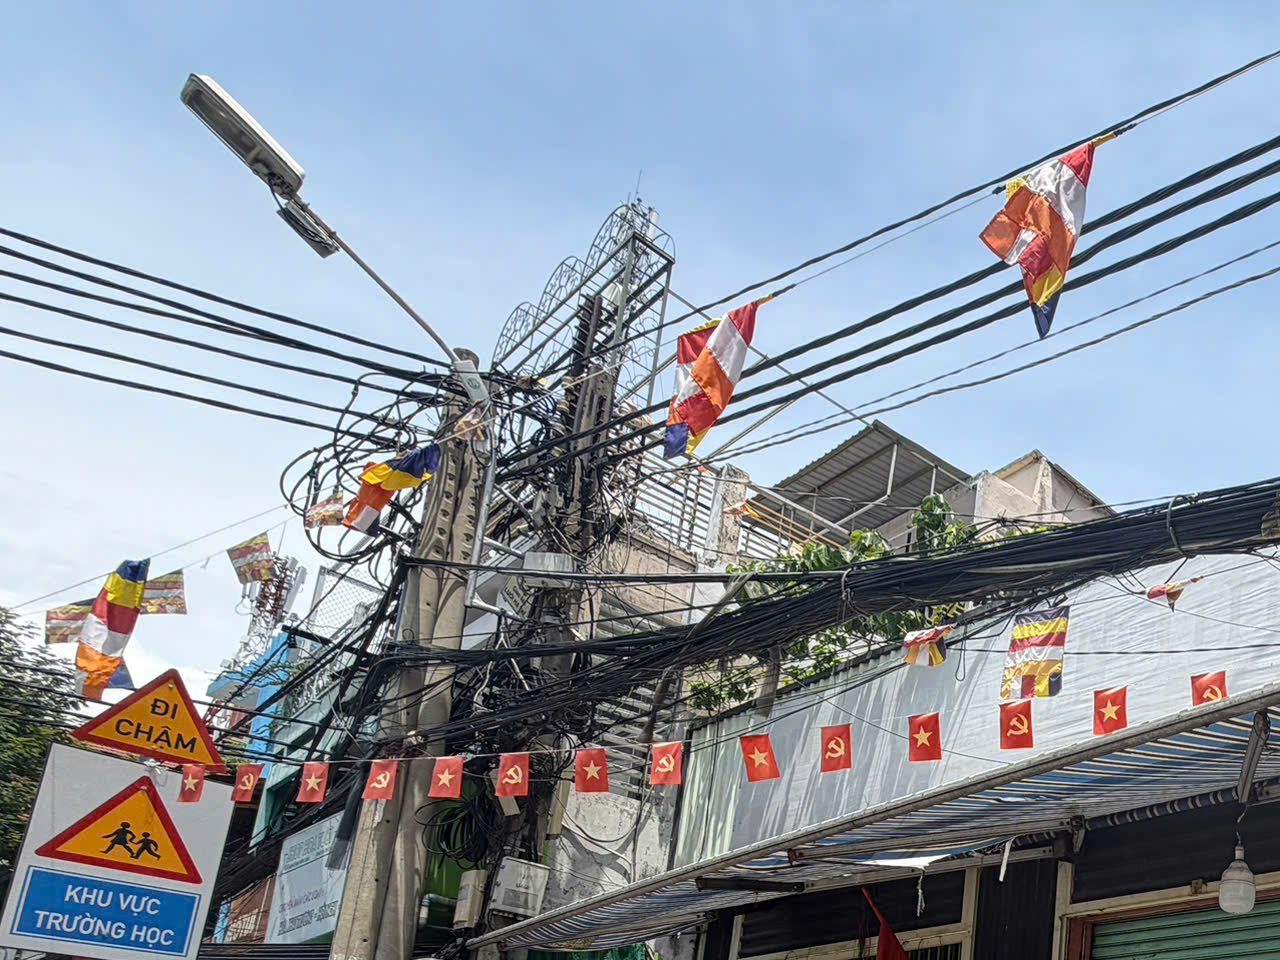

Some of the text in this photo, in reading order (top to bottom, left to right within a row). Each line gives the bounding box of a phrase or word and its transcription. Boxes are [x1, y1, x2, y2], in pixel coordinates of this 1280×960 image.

[150, 698, 178, 719] ĐI
[115, 719, 197, 753] CHẬM
[64, 884, 161, 916] KHU VỰC
[34, 910, 175, 947] TRƯỜNG HỌC
